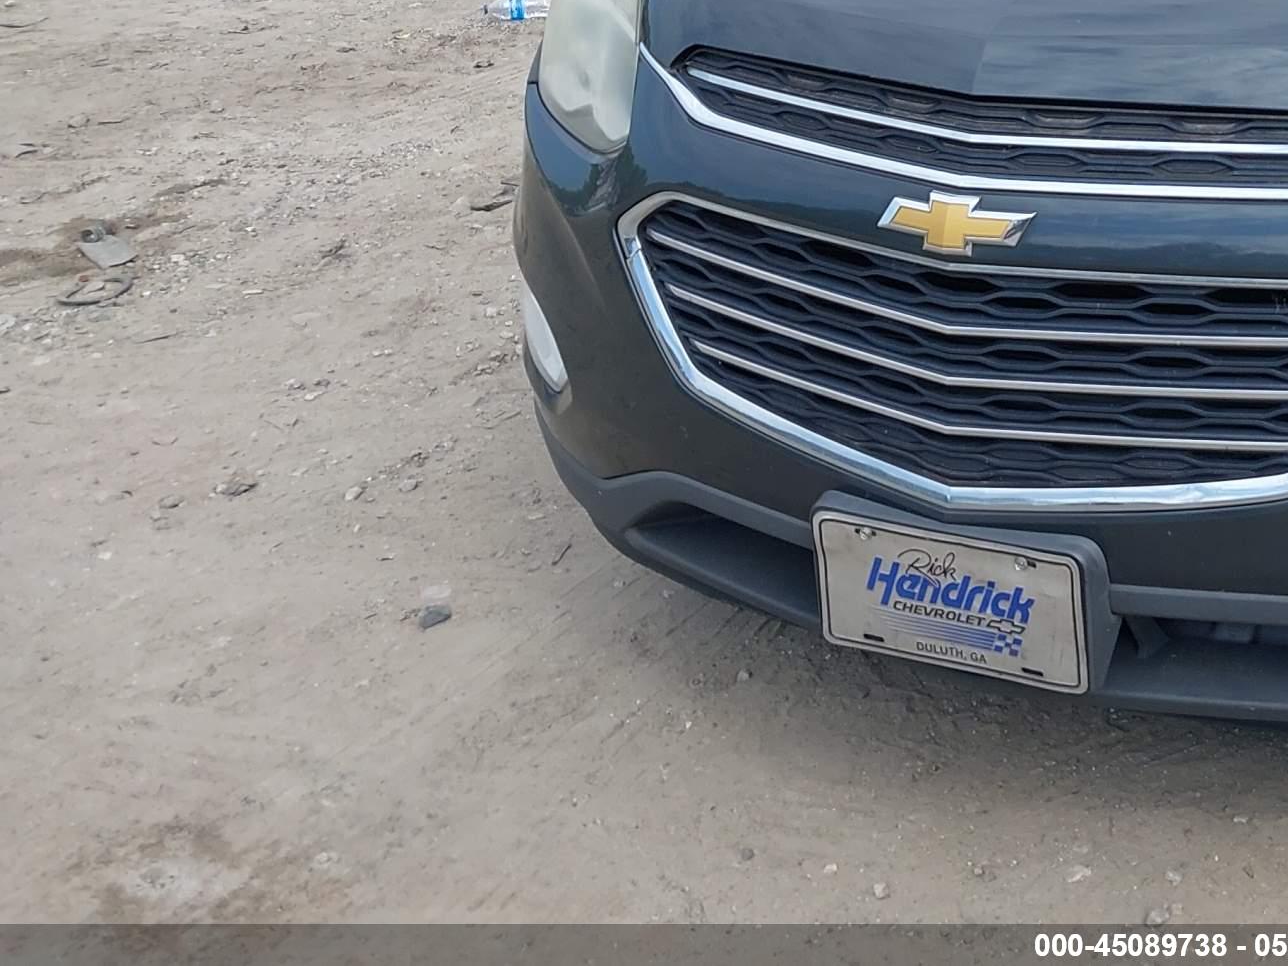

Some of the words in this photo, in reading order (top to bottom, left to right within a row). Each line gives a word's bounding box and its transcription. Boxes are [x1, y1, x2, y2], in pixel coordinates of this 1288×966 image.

[897, 548, 958, 587] Rick
[866, 556, 1037, 624] Hendrick
[893, 600, 986, 627] CHEVROLET
[916, 641, 968, 661] DULUTH,
[969, 651, 988, 664] GA
